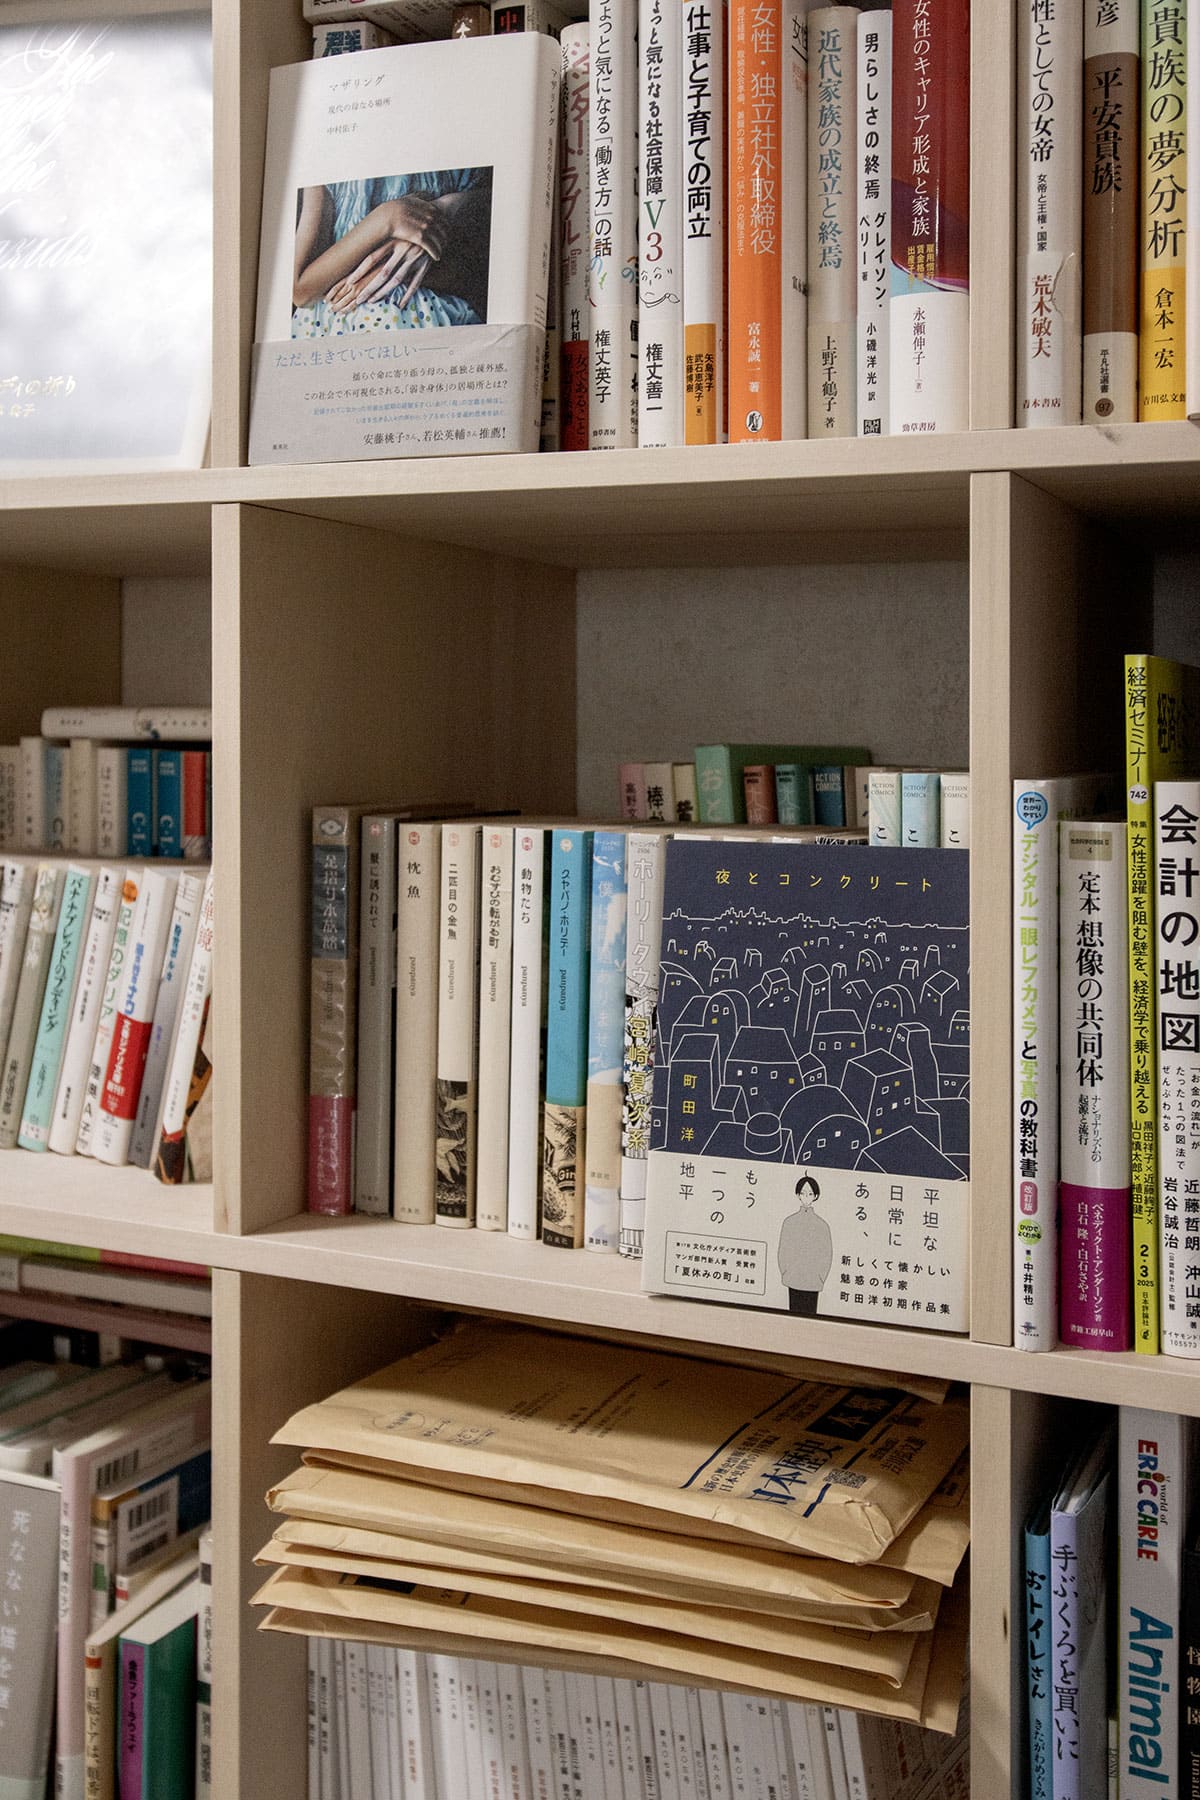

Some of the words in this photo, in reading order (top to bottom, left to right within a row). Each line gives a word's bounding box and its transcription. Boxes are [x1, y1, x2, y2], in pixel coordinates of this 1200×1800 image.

[1030, 0, 1055, 163] 性としての女帝
[595, 0, 612, 256] ょっと気になる「働き方」の話
[687, 5, 712, 240] 仕事と子育ての両立
[750, 2, 776, 255] 女性・独立社外取締役
[864, 33, 880, 199] 男らしさの終焉
[911, 0, 931, 236] 女性のキャリア形成と家族
[1091, 67, 1123, 194] 平安貴族
[1148, 0, 1187, 259] 貴族の夢分析
[817, 28, 842, 269] 近代家族の成立と終焉
[859, 215, 869, 265] ペリー
[1037, 174, 1048, 252] 女帝と王権・国家
[873, 211, 888, 308] グレイソン・
[912, 307, 927, 366] 永瀬伸子
[1032, 275, 1053, 359] 荒木敏夫
[1154, 287, 1175, 369] 倉本一宏
[595, 329, 611, 404] 権丈英子
[646, 342, 663, 411] 権丈善一
[821, 335, 838, 412] 上野千鶴子
[866, 322, 878, 385] 小磯洋光
[1099, 350, 1110, 393] 平凡社選書
[824, 417, 836, 429] 著
[1023, 397, 1062, 409] 青木書店
[1127, 666, 1147, 783] 経済セミナー
[1130, 790, 1147, 799] 742
[876, 826, 888, 840] こ
[908, 829, 919, 843] こ
[949, 829, 960, 843] こ
[407, 861, 421, 898] 枕魚
[448, 863, 459, 940] 二匹目の金魚
[489, 865, 502, 949] おむすびの転がる町
[520, 868, 532, 925] 動物たち
[715, 868, 932, 892] 夜とコンクリート
[1078, 871, 1101, 915] 定本
[1158, 804, 1200, 1054] 会計の地図
[409, 956, 417, 997] panpanya
[447, 959, 455, 1000] panpanya
[520, 965, 528, 1007] panpanya
[559, 968, 567, 1011] panpanya
[1020, 833, 1039, 1178] デジタル一眼レフカメラと写真の教科書
[1075, 919, 1105, 1088] 想像の共同体
[628, 1015, 650, 1150] 宮崎夏次系
[680, 1074, 698, 1142] 町田洋
[1162, 1065, 1171, 1132] ぜんぶわかる
[1091, 1095, 1102, 1163] ナショナリズムの
[1175, 1066, 1186, 1170] たった1つの図法で
[679, 1161, 695, 1200] 地平
[710, 1170, 728, 1224] 一つの
[745, 1169, 758, 1208] もう
[888, 1185, 905, 1247] 日常に
[922, 1188, 940, 1252] 平坦な
[1163, 1176, 1180, 1249] 岩谷誠治
[1184, 1179, 1200, 1251] 近藤哲朗
[674, 1265, 740, 1283] 「夏休みの町」
[840, 1273, 908, 1291] 魅惑の作家
[841, 1254, 951, 1277] 新しくて懐かしい
[1023, 1262, 1034, 1306] 中井精也
[1137, 1279, 1155, 1288] 2025
[1185, 1265, 1200, 1318] 沖山誠
[840, 1291, 951, 1315] 町田洋初期作品集
[1137, 1439, 1165, 1497] ERIC
[1137, 1499, 1160, 1562] CARLE
[1128, 1606, 1174, 1784] Animal
